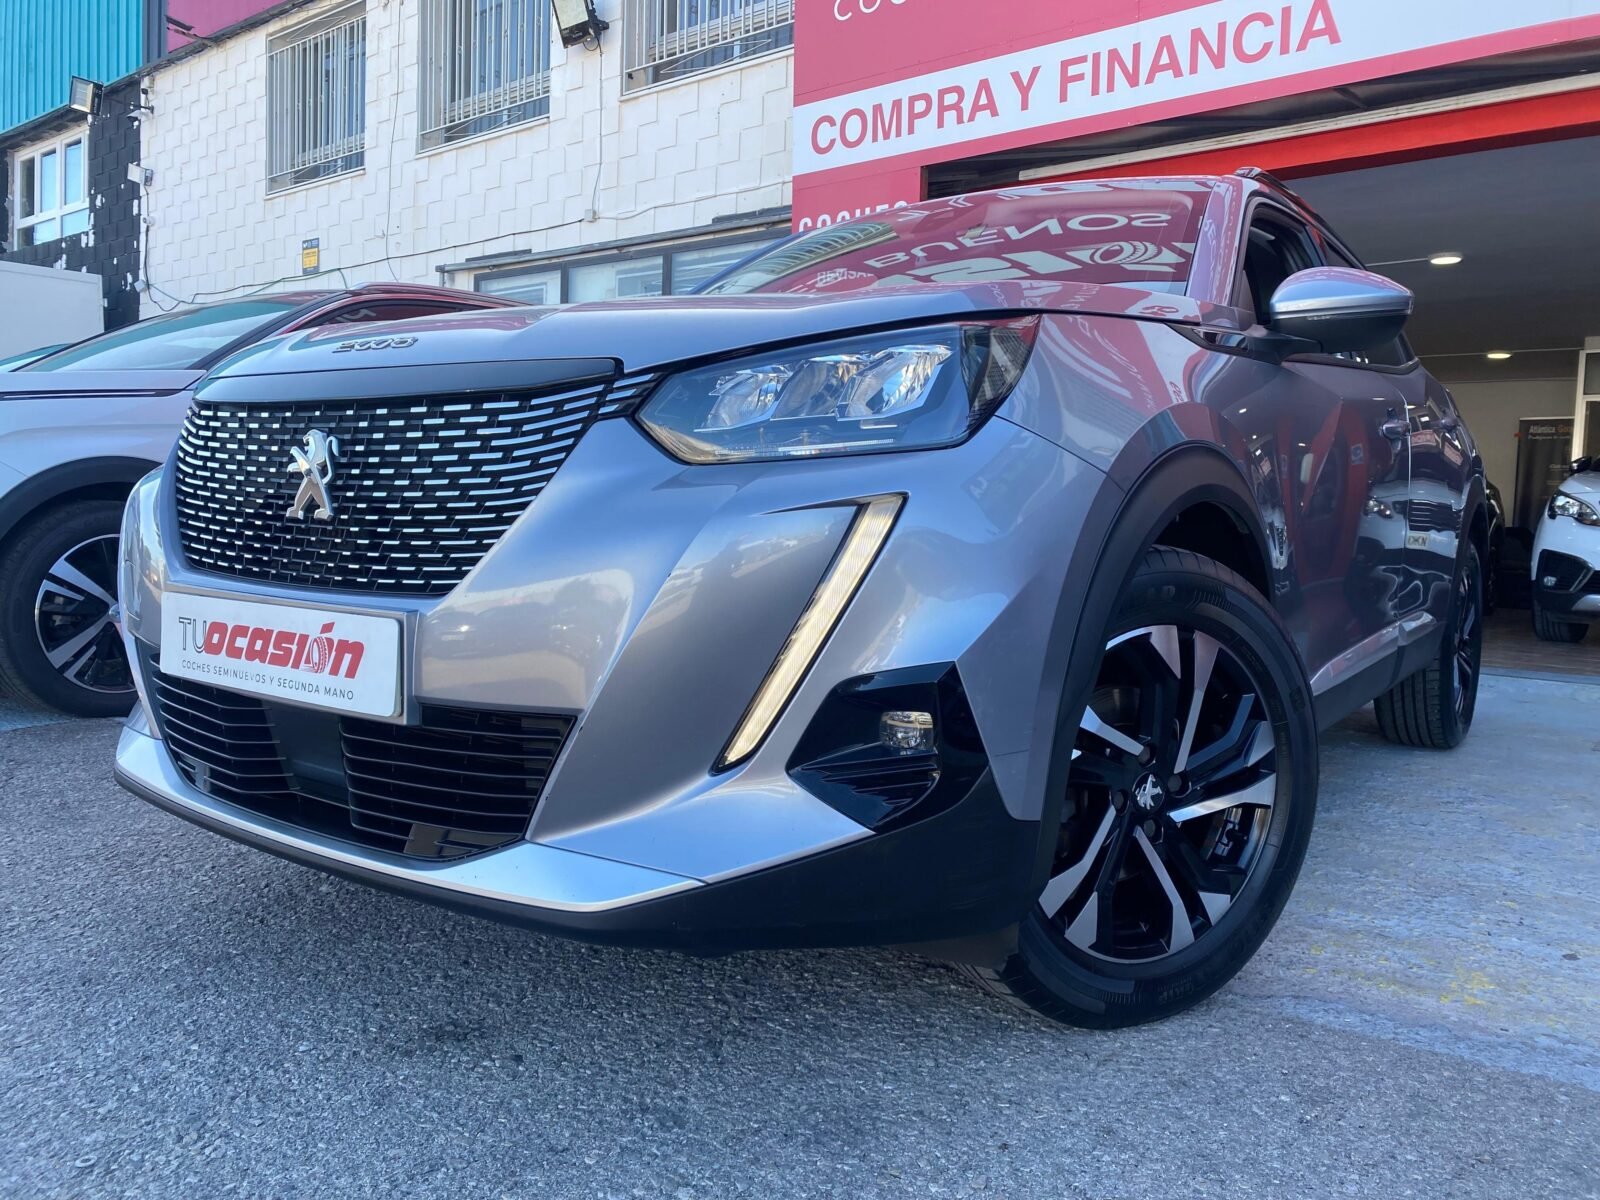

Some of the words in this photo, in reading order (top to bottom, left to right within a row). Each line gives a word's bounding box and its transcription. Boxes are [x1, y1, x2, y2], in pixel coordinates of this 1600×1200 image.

[811, 78, 999, 155] COMPRA
[1010, 65, 1042, 112] Y
[1060, 0, 1342, 103] FINANCIA
[181, 659, 211, 674] COCHES
[213, 665, 266, 685] SEMINUEVOS
[269, 676, 275, 685] Y
[277, 677, 321, 695] SEGUNDA
[323, 685, 354, 700] MANO
